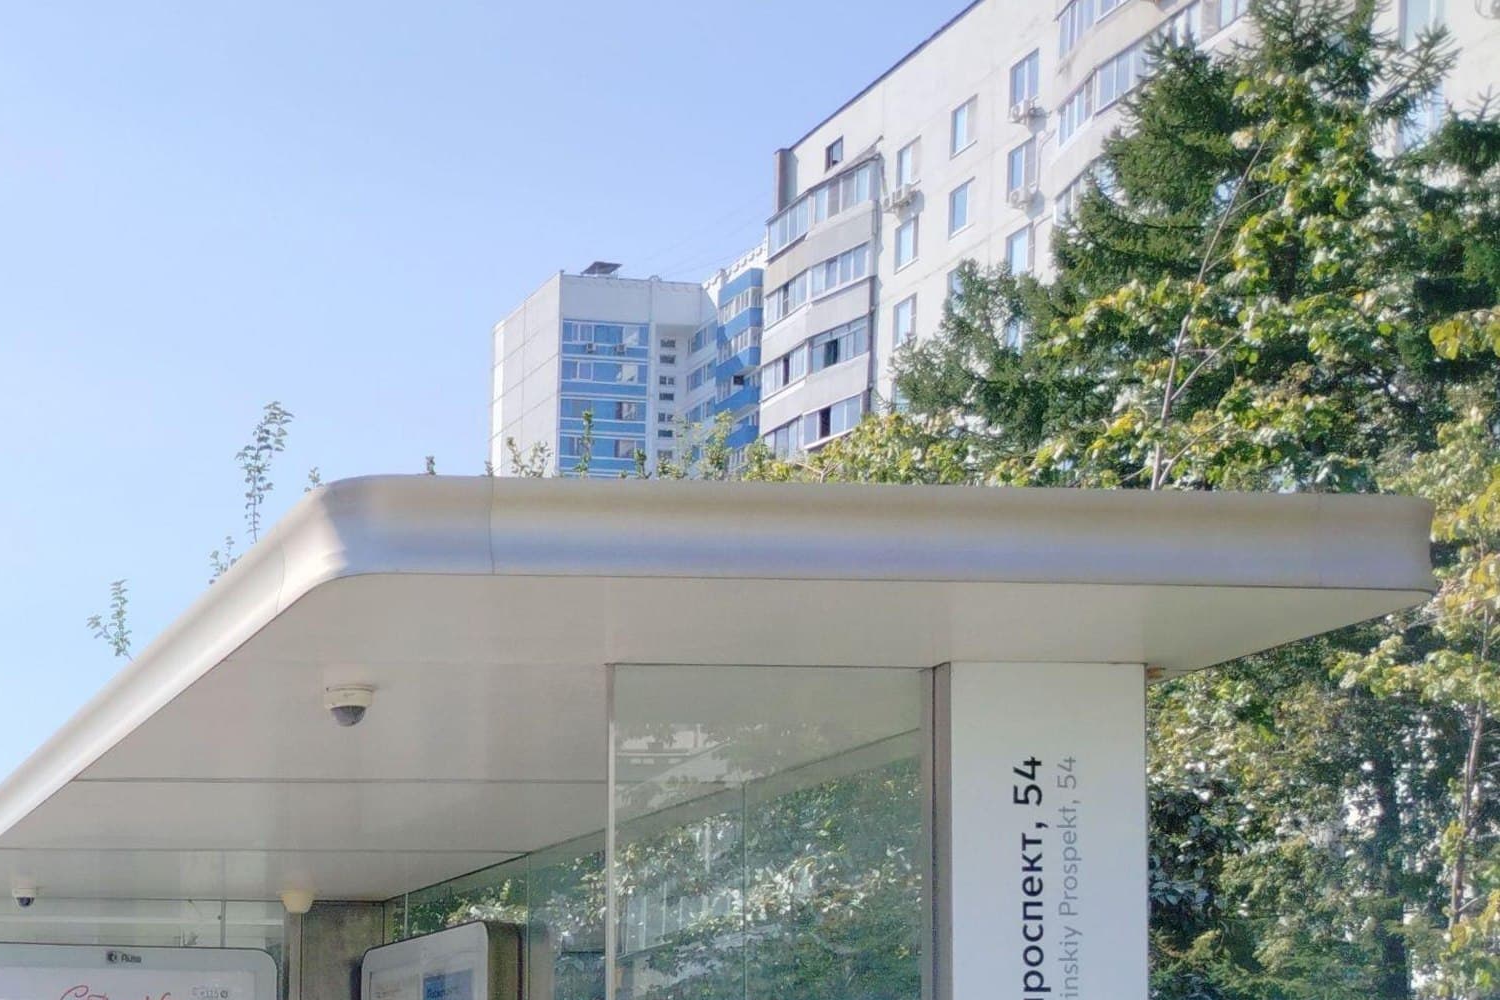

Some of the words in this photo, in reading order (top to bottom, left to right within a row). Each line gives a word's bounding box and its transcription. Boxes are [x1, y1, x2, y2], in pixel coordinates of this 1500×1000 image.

[1013, 756, 1043, 807] 54
[1057, 756, 1077, 790] 54
[1057, 800, 1083, 916] Prospekt,
